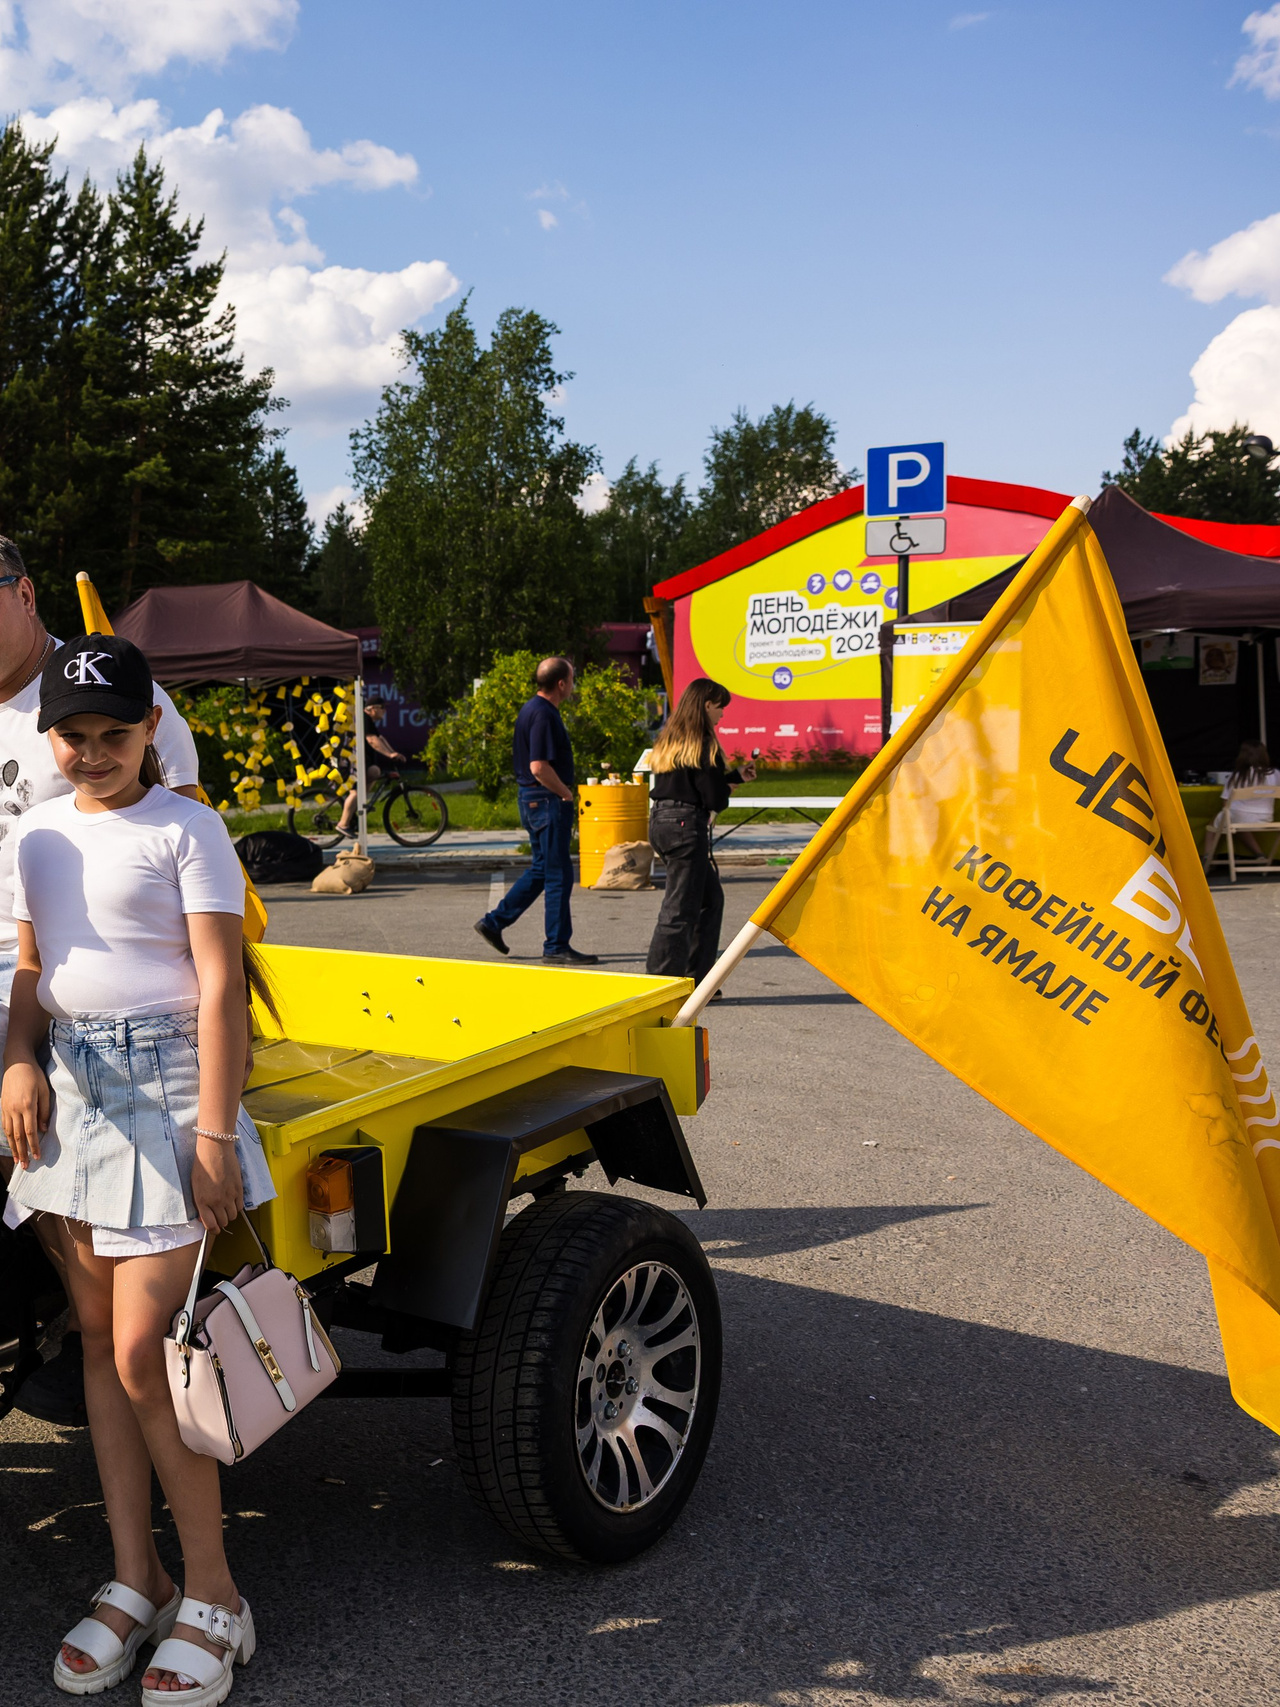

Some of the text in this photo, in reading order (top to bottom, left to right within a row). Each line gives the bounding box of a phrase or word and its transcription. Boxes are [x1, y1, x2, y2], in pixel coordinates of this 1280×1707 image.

[888, 452, 931, 508] P
[750, 596, 804, 619] ДЕНЬ
[750, 608, 878, 636] МОЛОДЁЖИ
[835, 632, 879, 654] 202
[1049, 727, 1166, 859] ЧЕ
[921, 886, 1110, 1026] НА ЯМАЛЕ
[953, 844, 1229, 1064] КОФЕЙНЫЙ ФЕ
